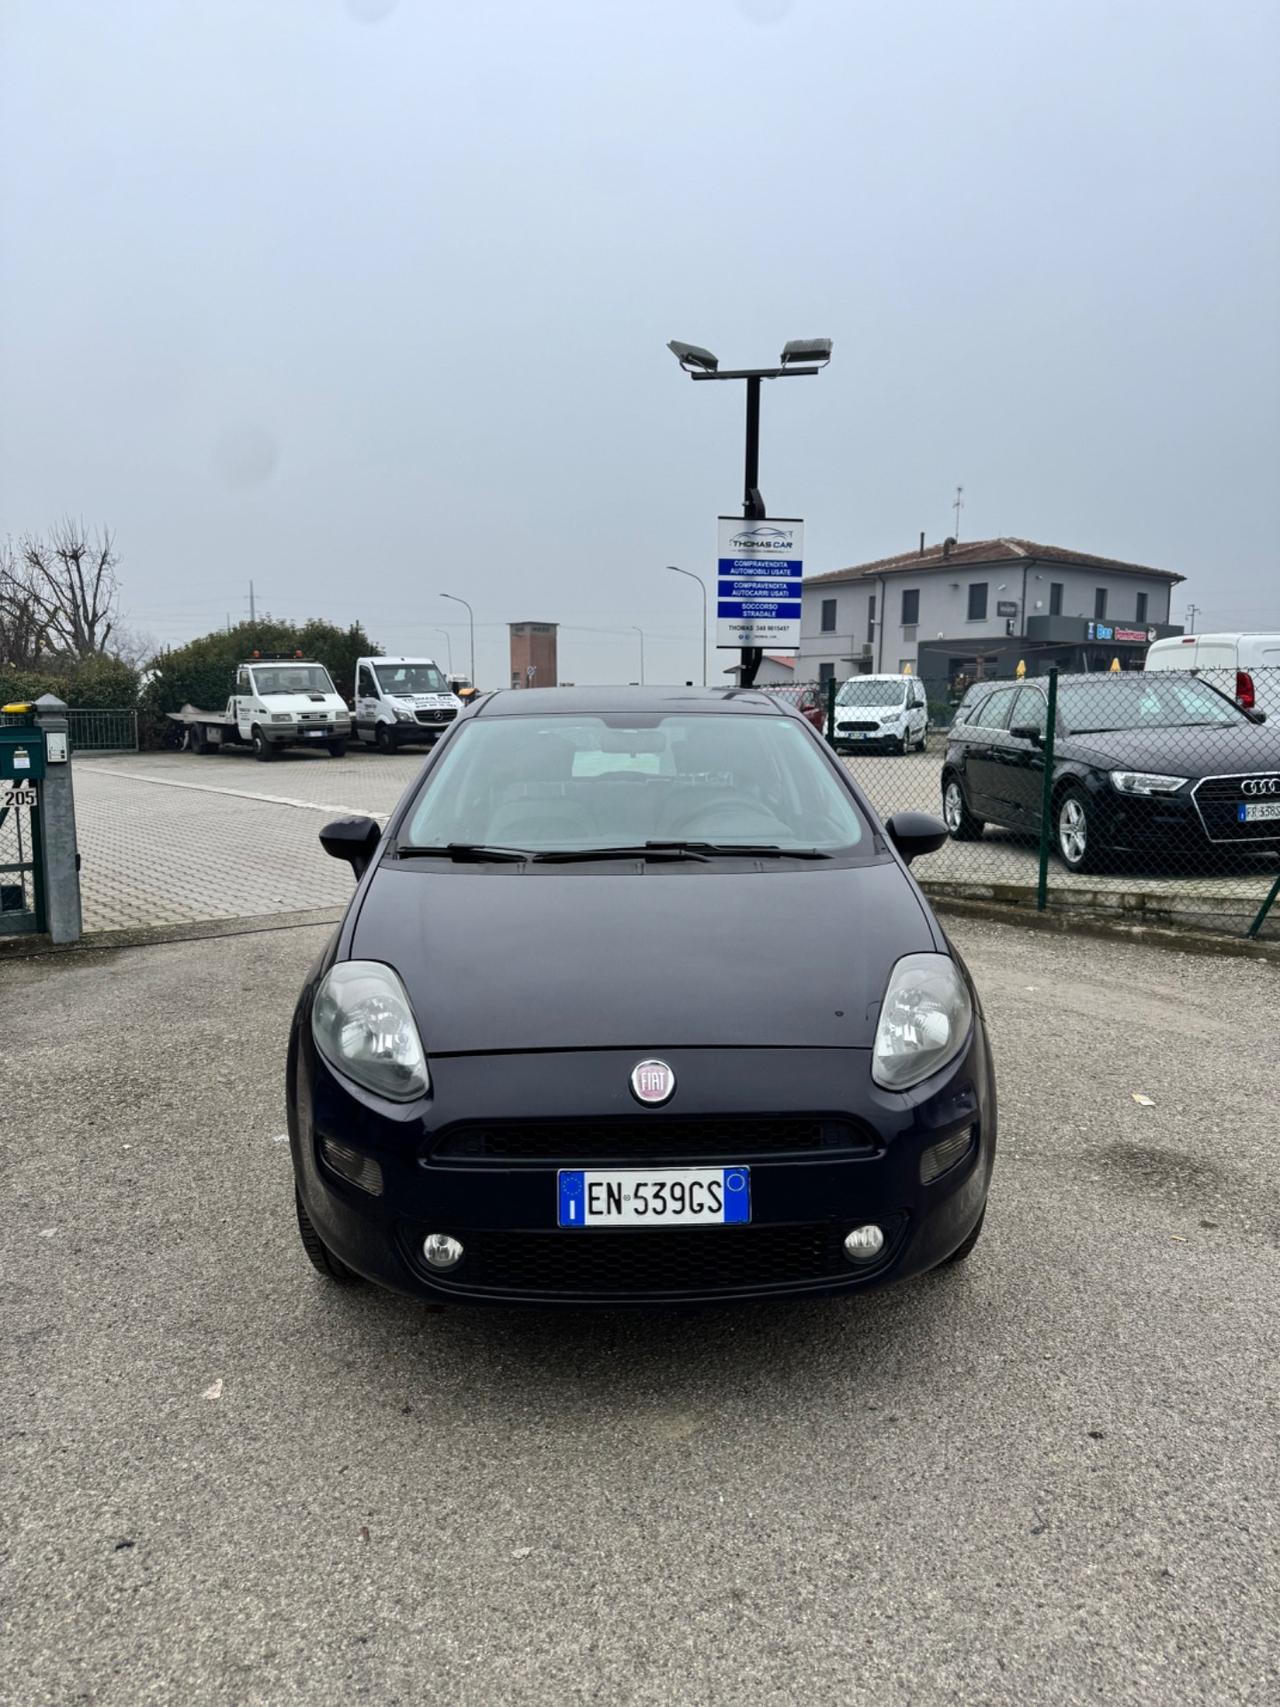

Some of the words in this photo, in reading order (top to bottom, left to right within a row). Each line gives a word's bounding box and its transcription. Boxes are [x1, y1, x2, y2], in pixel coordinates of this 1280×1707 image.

[733, 560, 788, 568] COMPRAVENDITA
[770, 568, 792, 576] USATE
[1097, 624, 1113, 640] Bar
[5, 790, 35, 806] 205
[641, 1072, 665, 1091] FIAT
